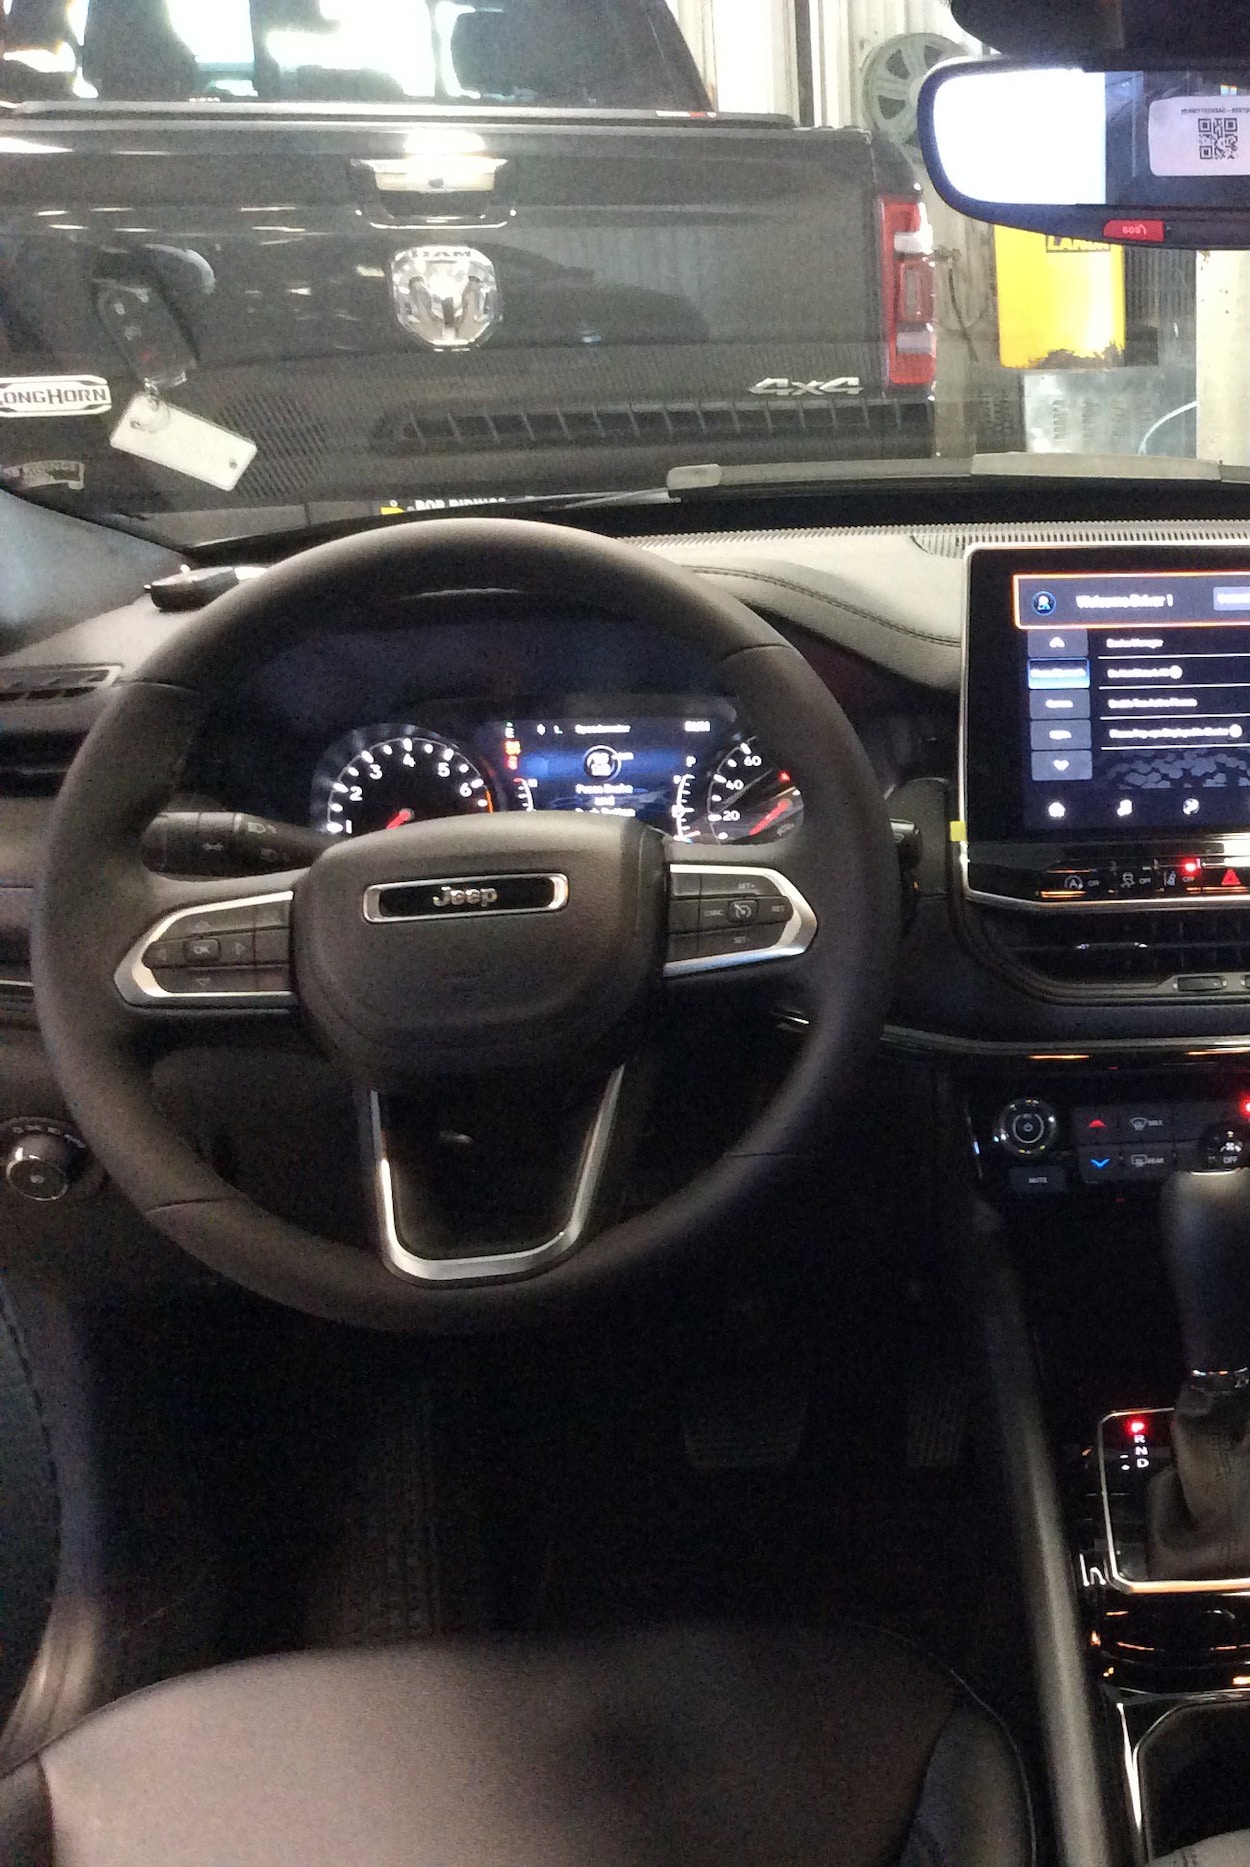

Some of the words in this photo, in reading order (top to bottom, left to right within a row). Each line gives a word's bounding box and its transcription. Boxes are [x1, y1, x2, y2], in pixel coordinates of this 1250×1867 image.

[0, 388, 107, 405] ONGHORN
[402, 753, 415, 768] 4
[743, 755, 762, 768] 60
[369, 765, 382, 780] 3
[438, 762, 450, 777] 5
[459, 782, 472, 798] 6
[725, 779, 744, 790] 40
[350, 786, 363, 801] 2
[722, 809, 741, 822] 20
[345, 821, 352, 835] 1
[432, 887, 498, 908] Jeep
[1222, 1155, 1238, 1164] OFF
[1133, 1434, 1146, 1444] R
[1135, 1445, 1149, 1456] N
[1136, 1458, 1150, 1468] D
